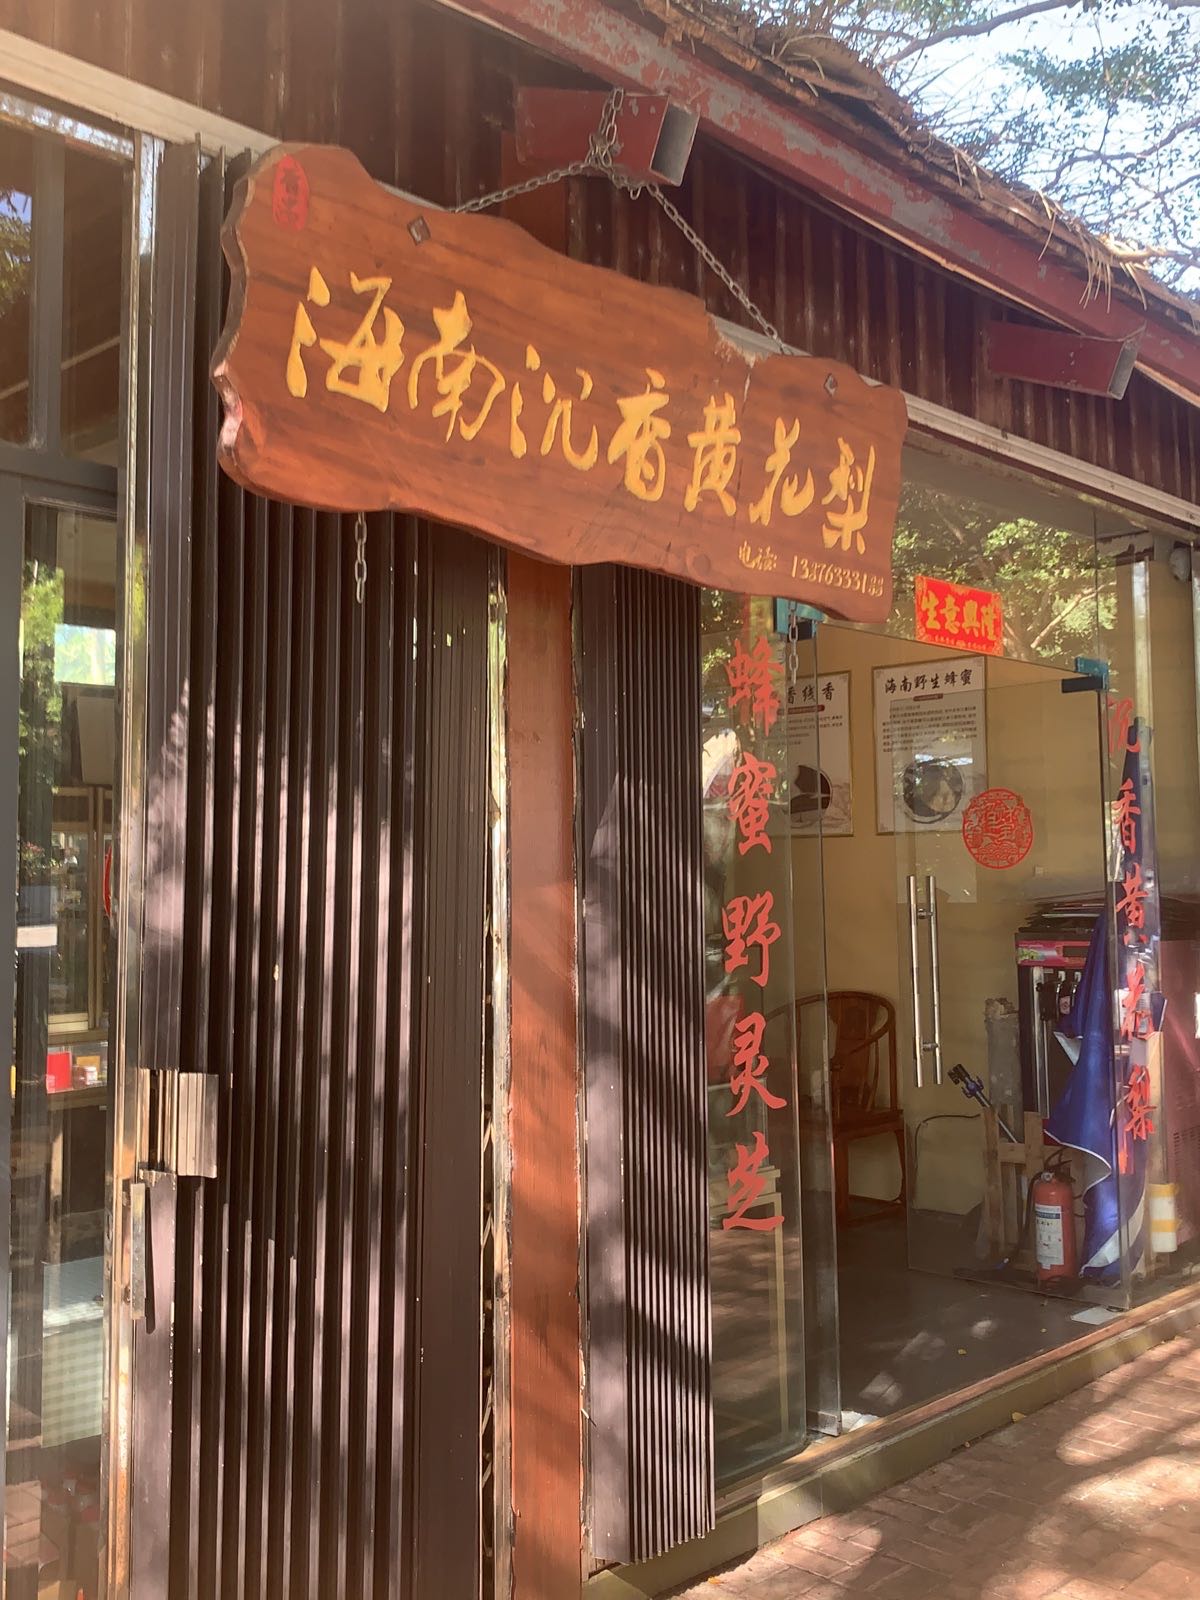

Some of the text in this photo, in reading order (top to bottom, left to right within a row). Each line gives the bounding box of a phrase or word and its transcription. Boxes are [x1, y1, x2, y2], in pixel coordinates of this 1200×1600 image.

[286, 266, 875, 554] 海南沉香黄花梨
[884, 668, 972, 694] 海南野生蜂蜜
[722, 636, 786, 1231] 蜂蜜野灵芝
